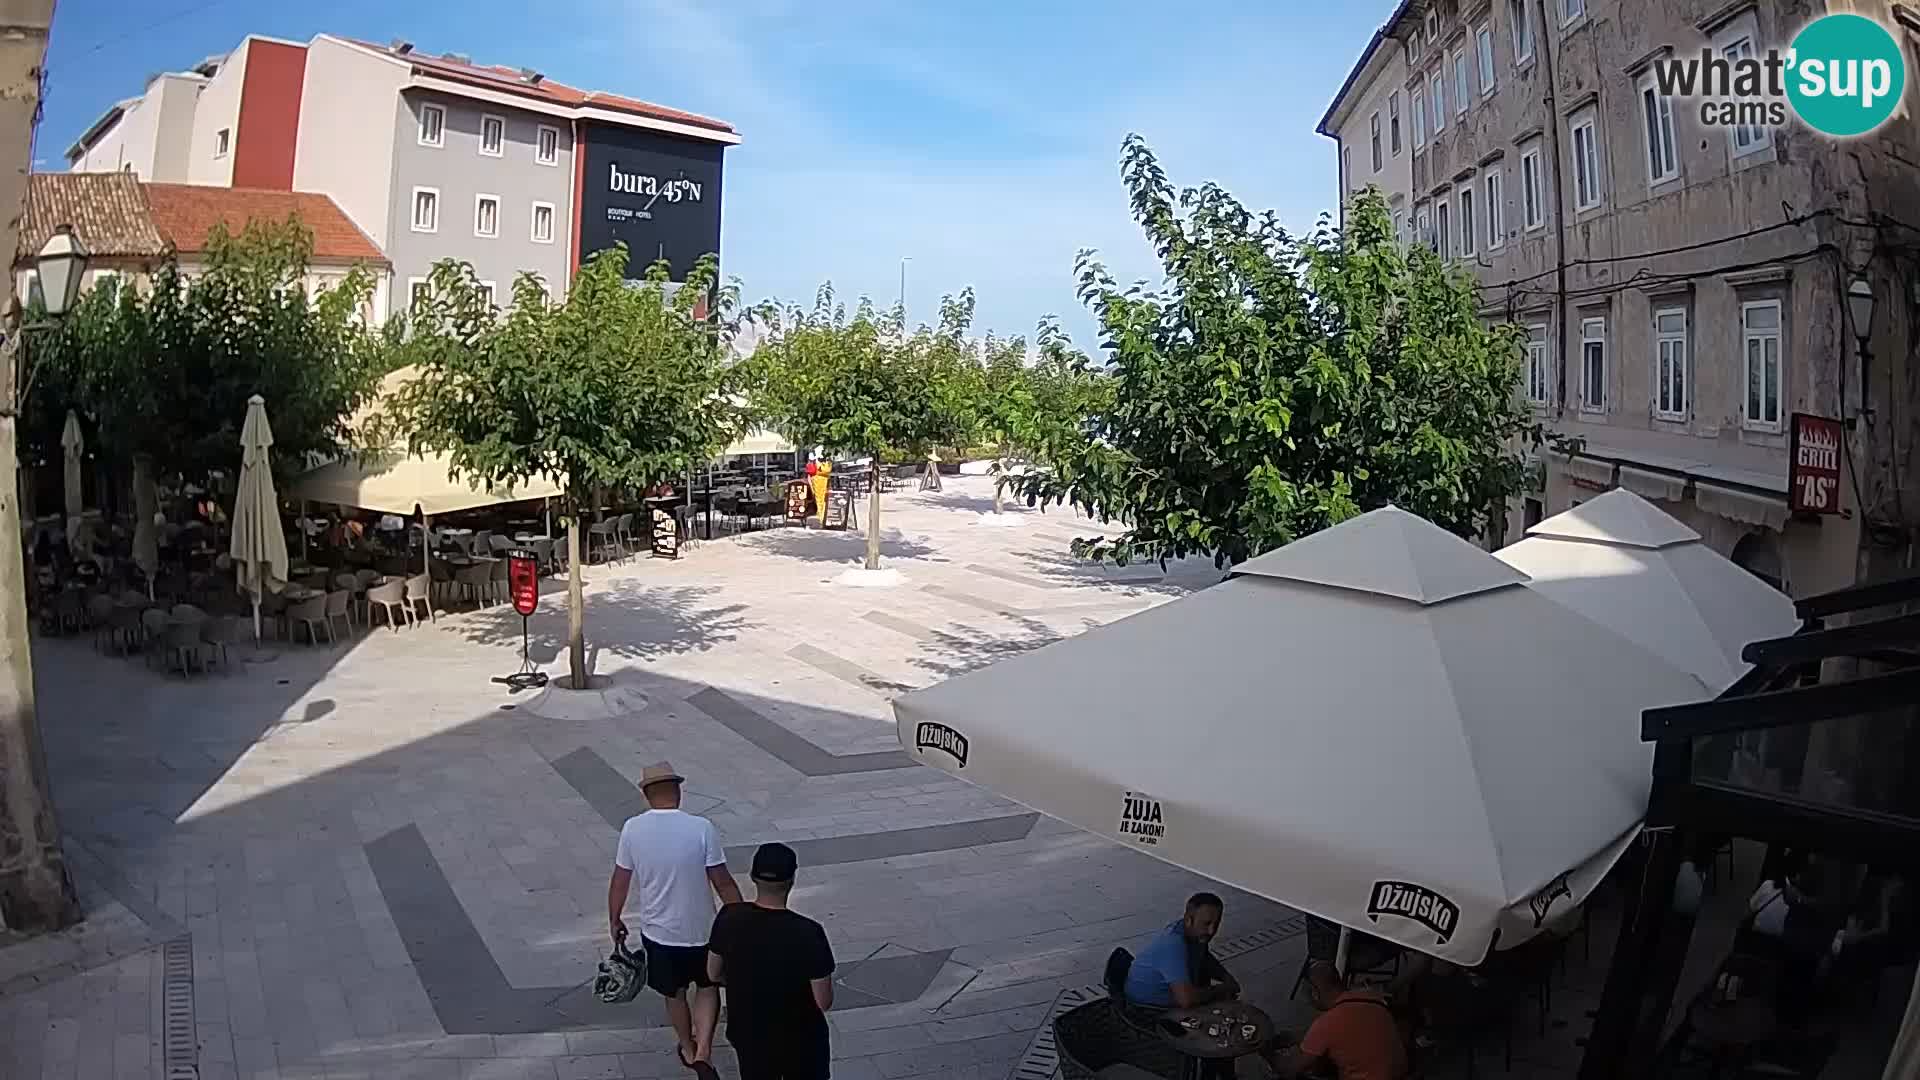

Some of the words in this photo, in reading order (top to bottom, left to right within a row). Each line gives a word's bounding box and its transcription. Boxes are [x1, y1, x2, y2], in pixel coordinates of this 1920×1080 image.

[610, 164, 657, 196] bura
[1798, 446, 1838, 471] GRILL
[920, 724, 965, 758] Ožujsko
[1122, 791, 1162, 823] ŽUJA
[1119, 820, 1130, 833] JE
[1130, 821, 1165, 838] ZAKON!
[1376, 884, 1452, 931] Ožujsko
